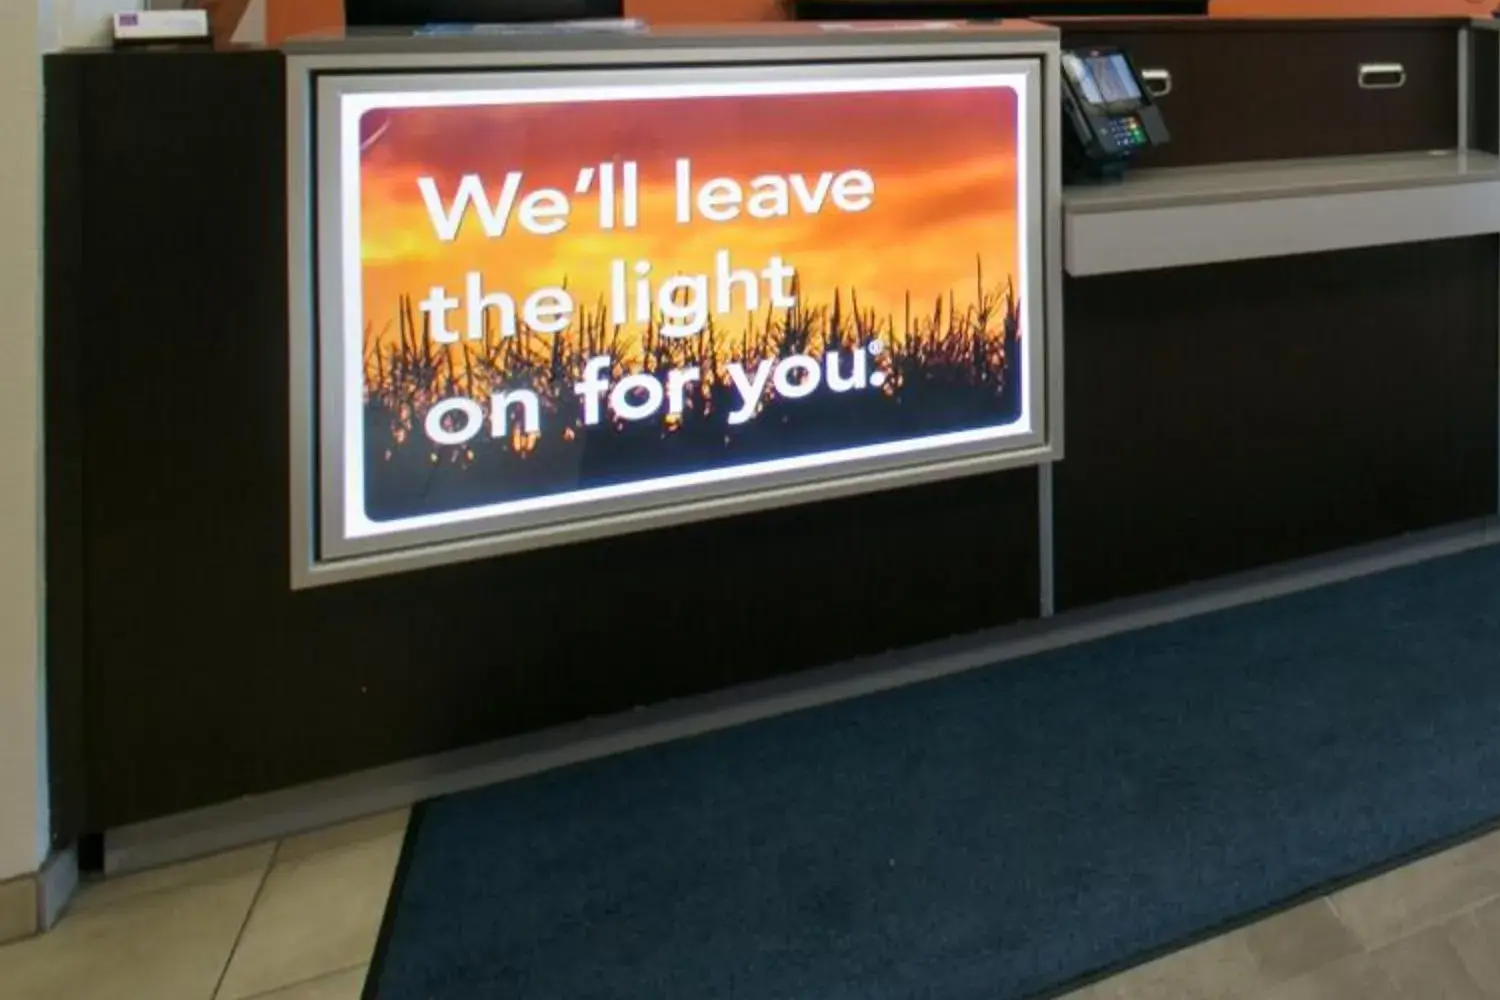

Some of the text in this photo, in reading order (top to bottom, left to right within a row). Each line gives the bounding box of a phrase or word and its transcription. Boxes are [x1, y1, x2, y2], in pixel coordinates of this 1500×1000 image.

[418, 158, 876, 242] We'll leave
[419, 250, 796, 345] the light
[423, 388, 541, 447] on
[575, 355, 702, 427] for
